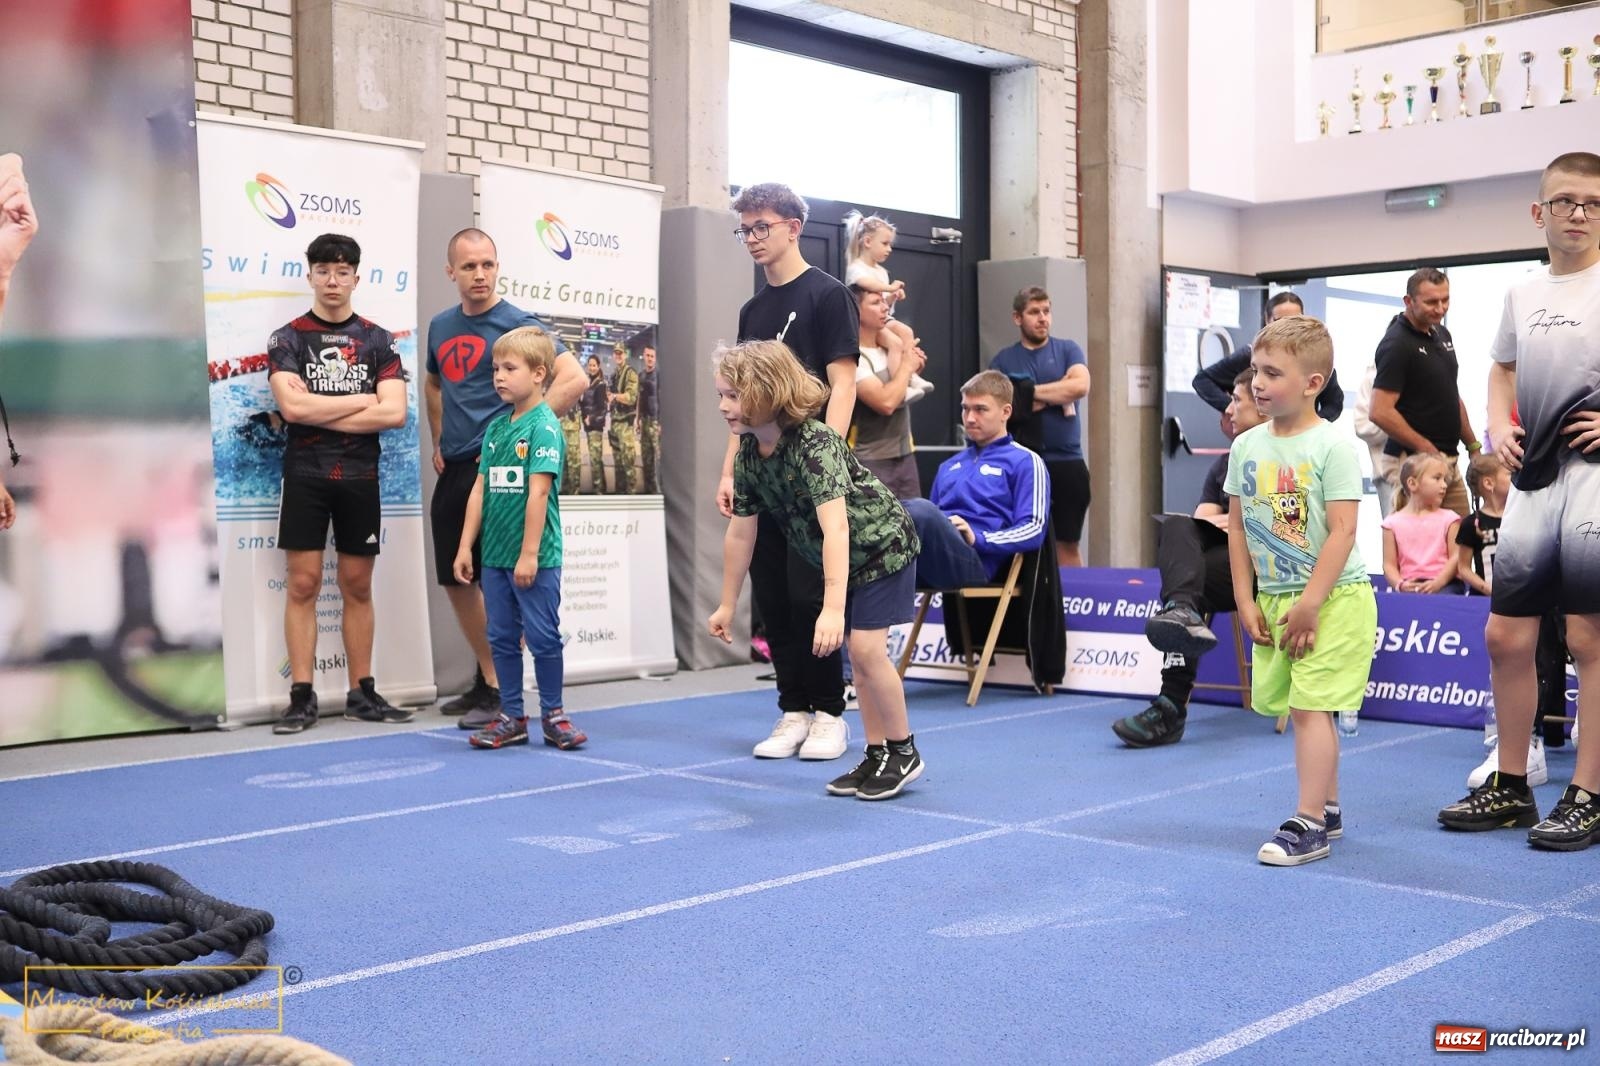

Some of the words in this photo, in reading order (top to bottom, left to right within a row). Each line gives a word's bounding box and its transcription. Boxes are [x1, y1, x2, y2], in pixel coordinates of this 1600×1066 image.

[299, 193, 362, 216] ZSOMS
[574, 230, 619, 250] ZSOMS
[496, 276, 552, 301] Straż
[558, 283, 656, 312] Graniczna
[563, 520, 639, 539] aciborz.pl
[1063, 597, 1094, 615] EGO
[1097, 602, 1112, 616] w
[1114, 598, 1163, 618] Racib
[1372, 619, 1469, 659] ąskie.
[314, 653, 346, 673] ląski
[1073, 647, 1140, 668] ZSOMS
